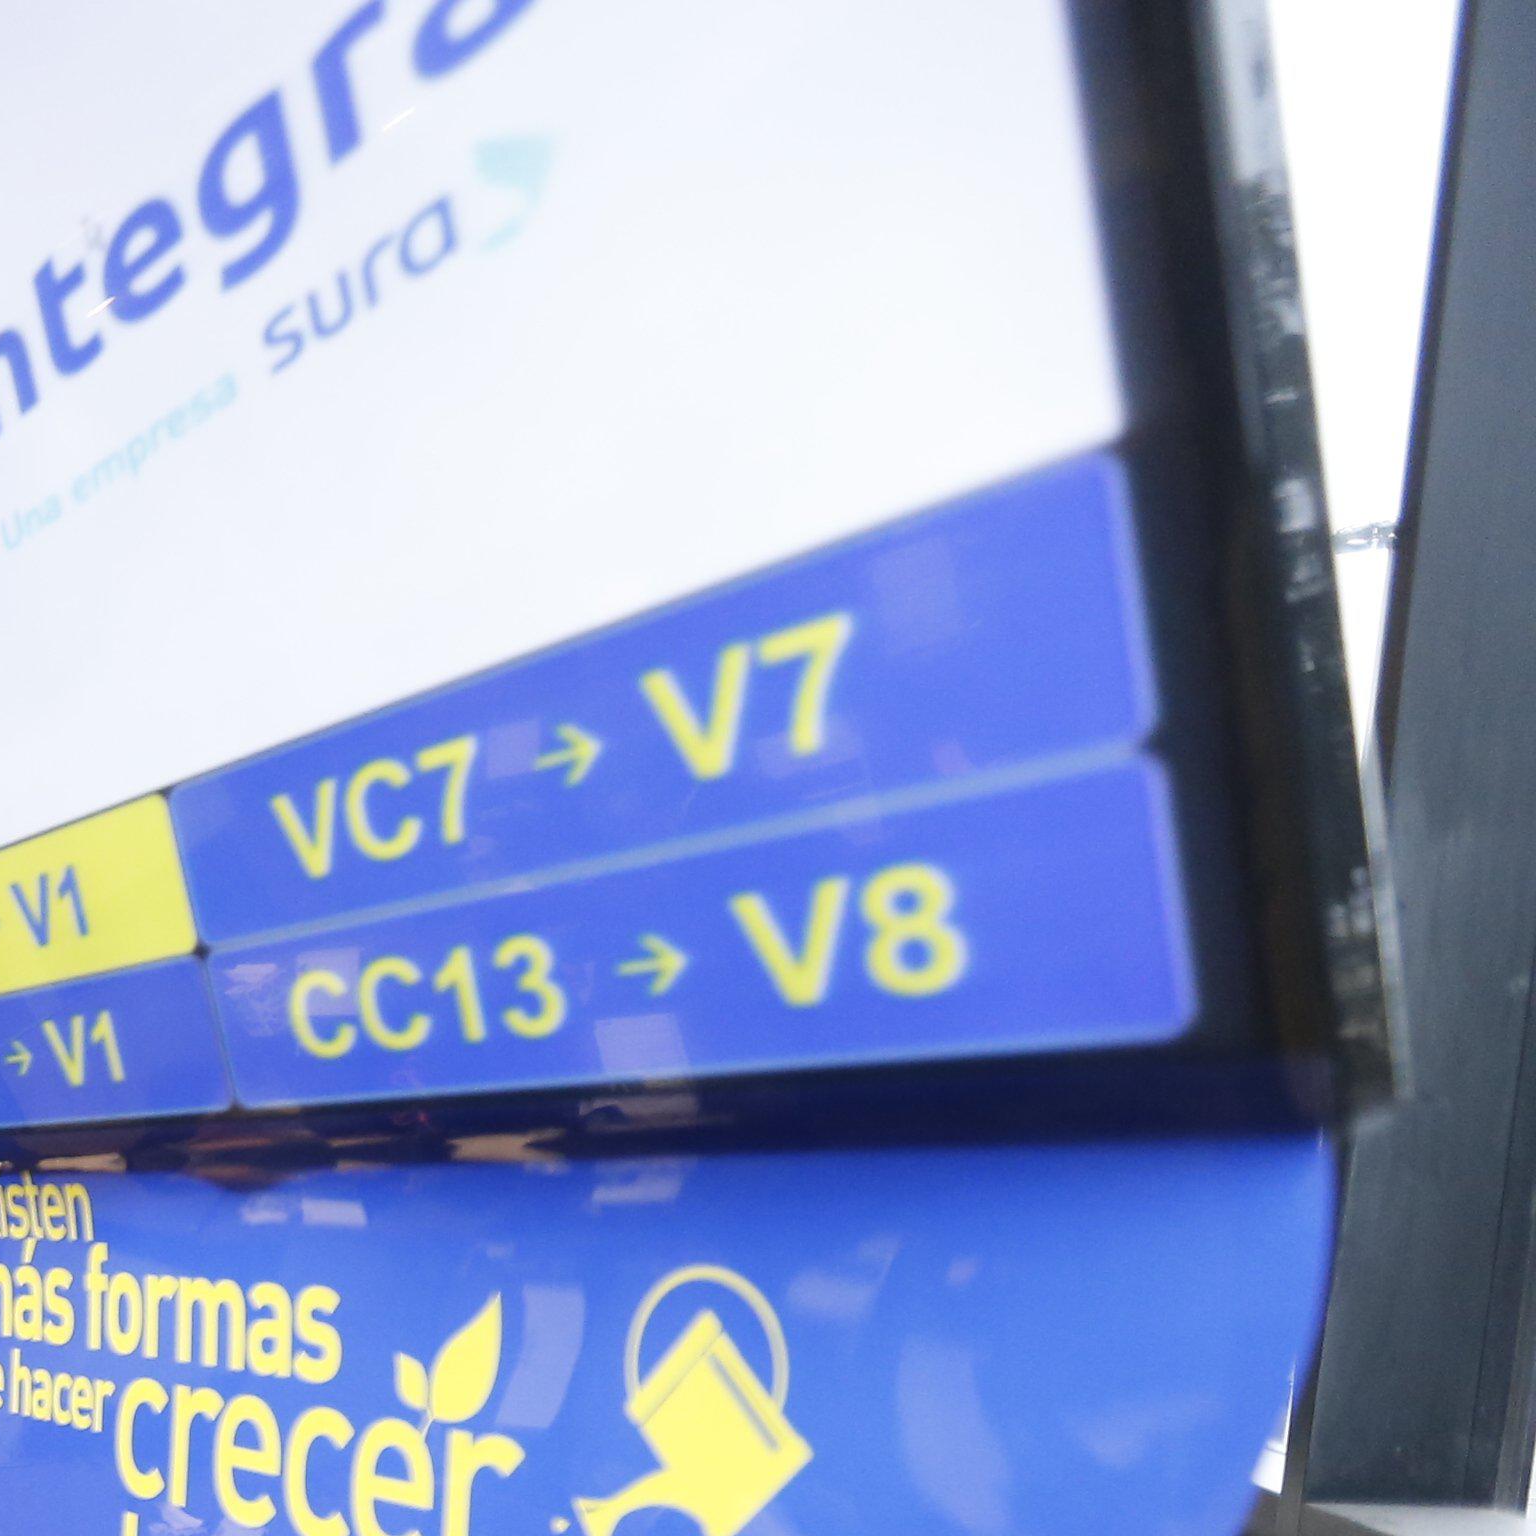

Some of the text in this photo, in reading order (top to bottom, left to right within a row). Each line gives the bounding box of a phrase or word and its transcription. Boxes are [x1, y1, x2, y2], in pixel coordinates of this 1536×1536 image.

[71, 371, 240, 506] empresa
[262, 193, 459, 376] sura
[270, 614, 854, 880] VC7 V7
[13, 867, 89, 947] V1
[288, 862, 970, 1062] CC13 V8
[42, 1011, 125, 1090] V1
[84, 1242, 343, 1384] formas
[9, 1347, 115, 1433] hacer
